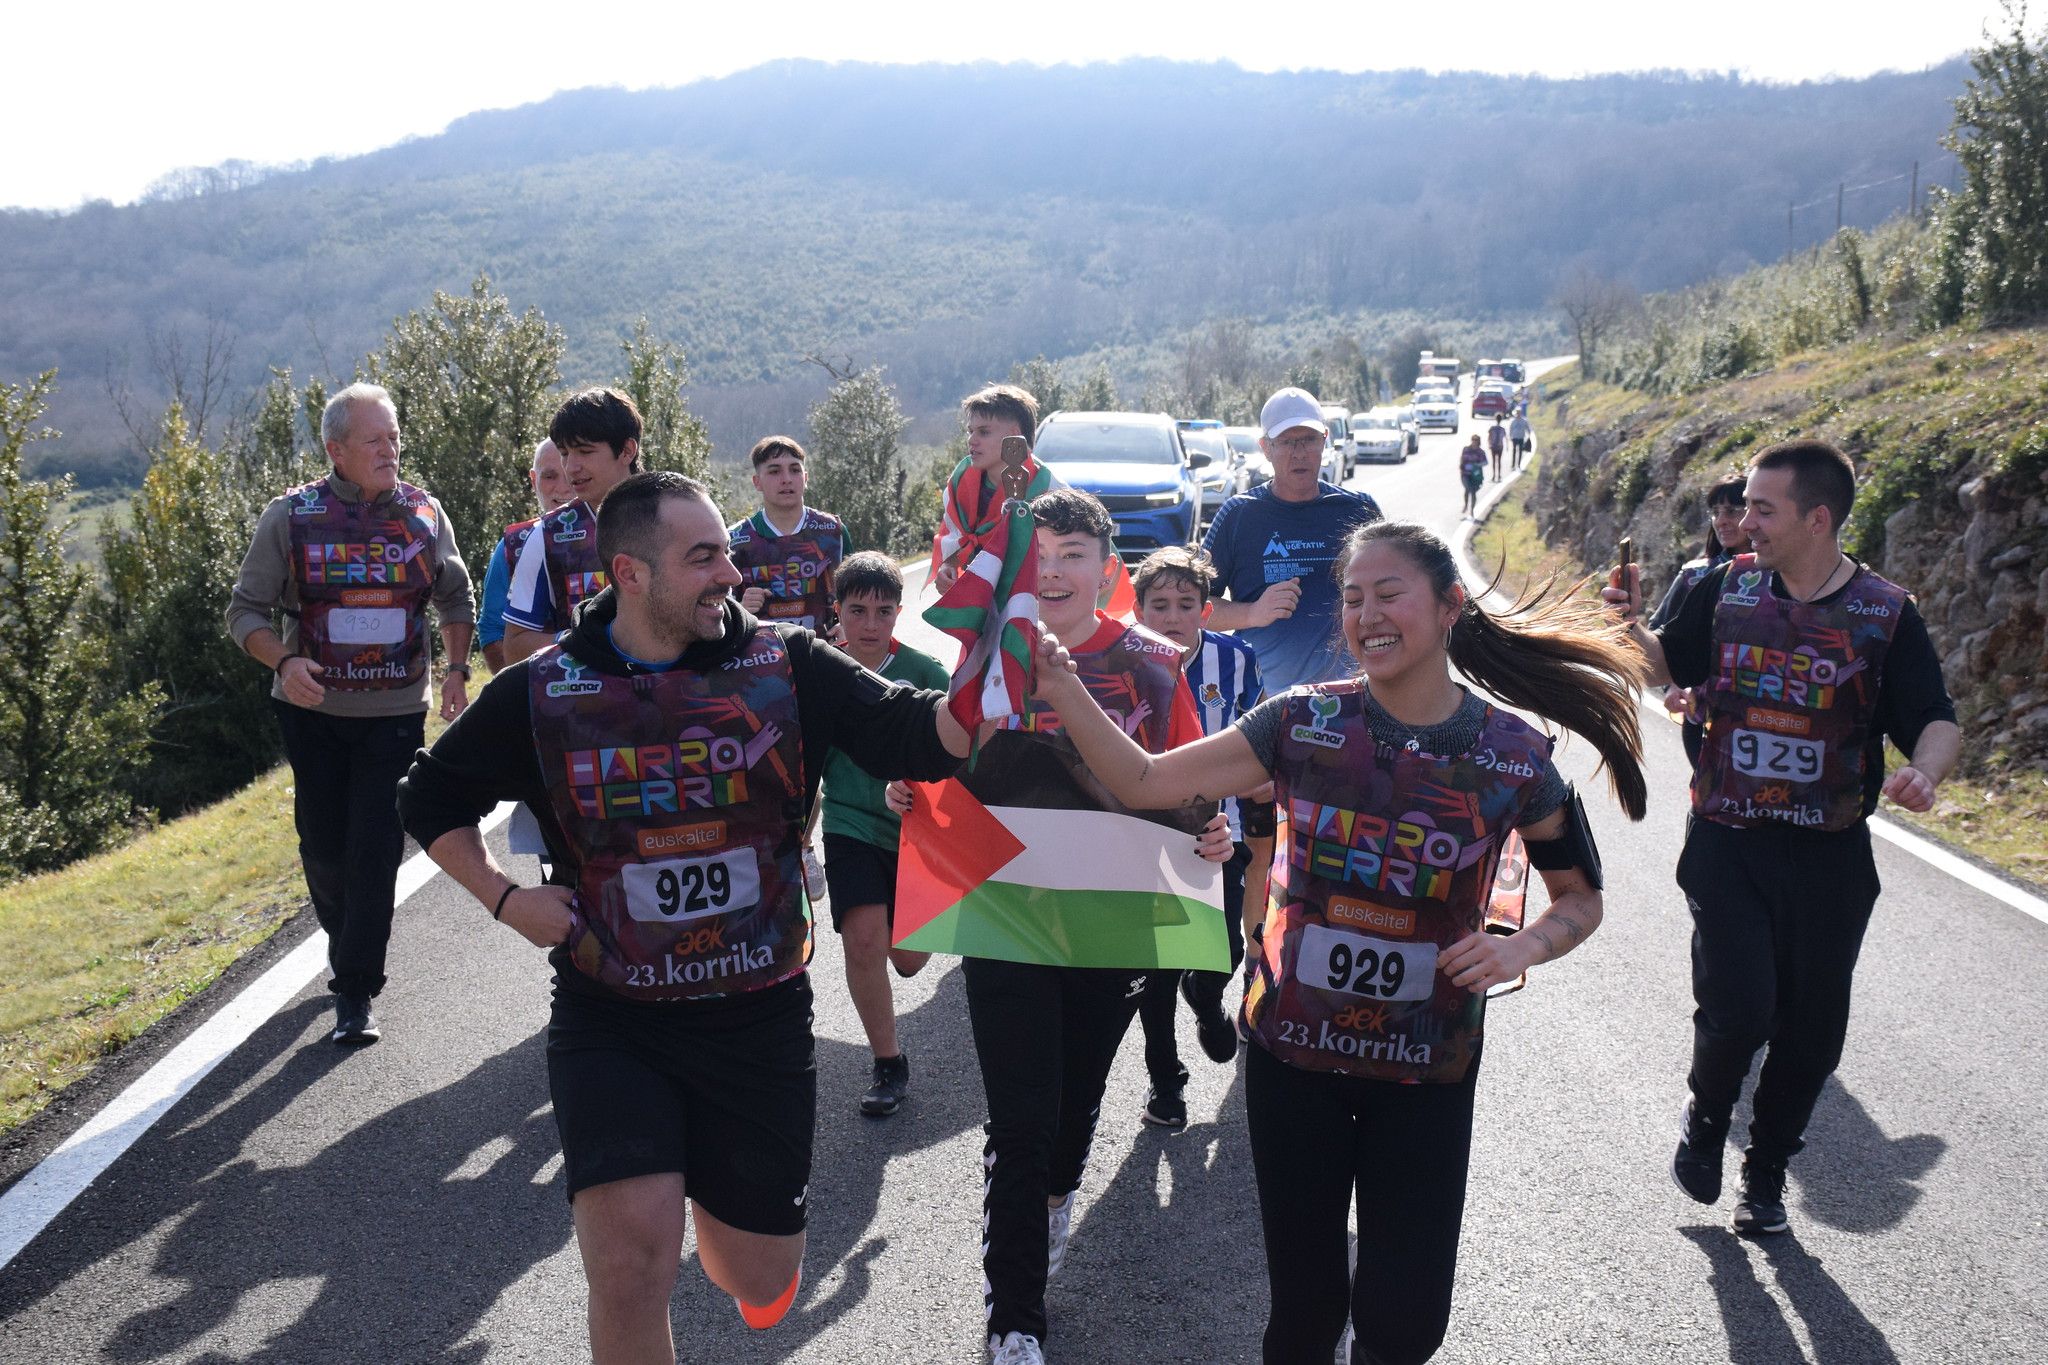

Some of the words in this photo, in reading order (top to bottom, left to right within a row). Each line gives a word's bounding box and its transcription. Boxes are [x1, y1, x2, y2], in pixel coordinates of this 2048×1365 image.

[1862, 603, 1890, 617] eitb
[741, 651, 780, 669] eitb
[1142, 643, 1176, 657] eitb
[1750, 713, 1806, 729] euskaltel
[565, 737, 745, 788] HARRO
[1495, 757, 1534, 778] eitb
[1737, 734, 1818, 775] 929
[644, 826, 721, 850] euskaltel
[1289, 798, 1460, 868] HARRO
[656, 861, 731, 917] 929
[1333, 902, 1410, 930] euskaltel
[673, 917, 726, 956] aek
[1327, 943, 1406, 998] 929
[1334, 1003, 1391, 1035] aek
